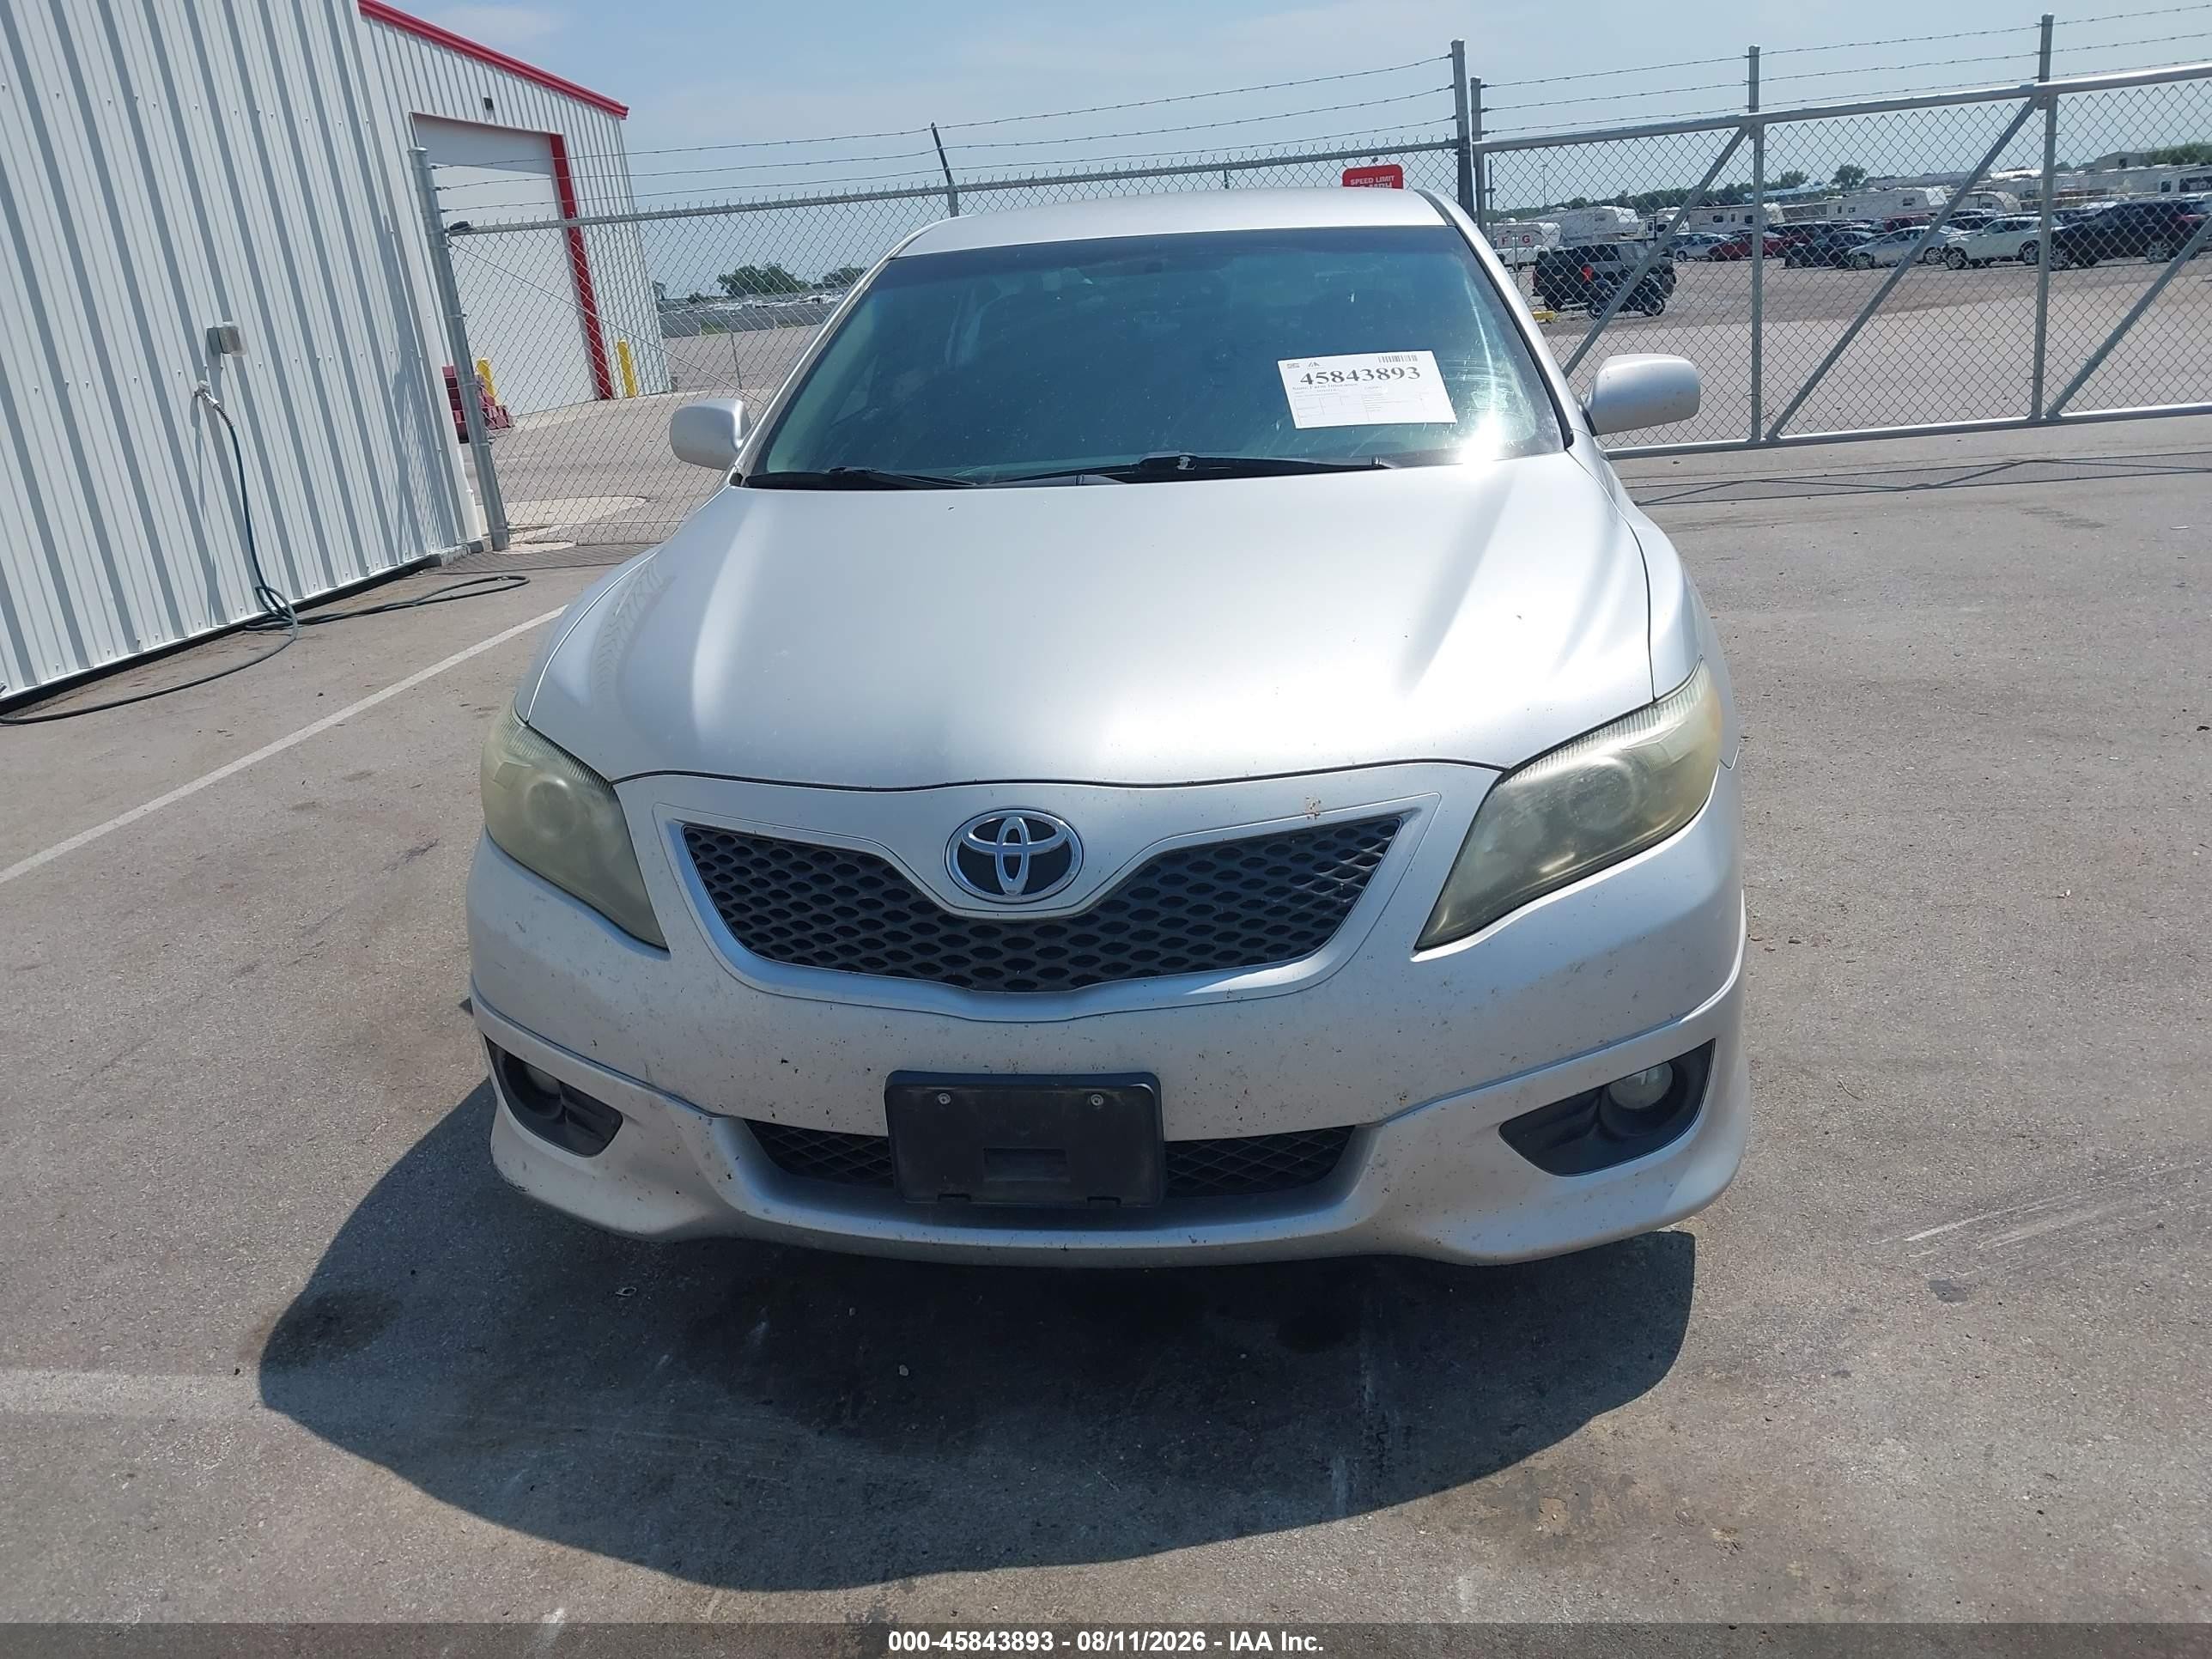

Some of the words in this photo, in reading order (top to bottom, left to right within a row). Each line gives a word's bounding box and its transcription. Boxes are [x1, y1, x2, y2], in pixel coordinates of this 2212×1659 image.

[1350, 177, 1374, 185] SPEED
[1522, 234, 1531, 244] G
[1299, 366, 1421, 386] 45843893
